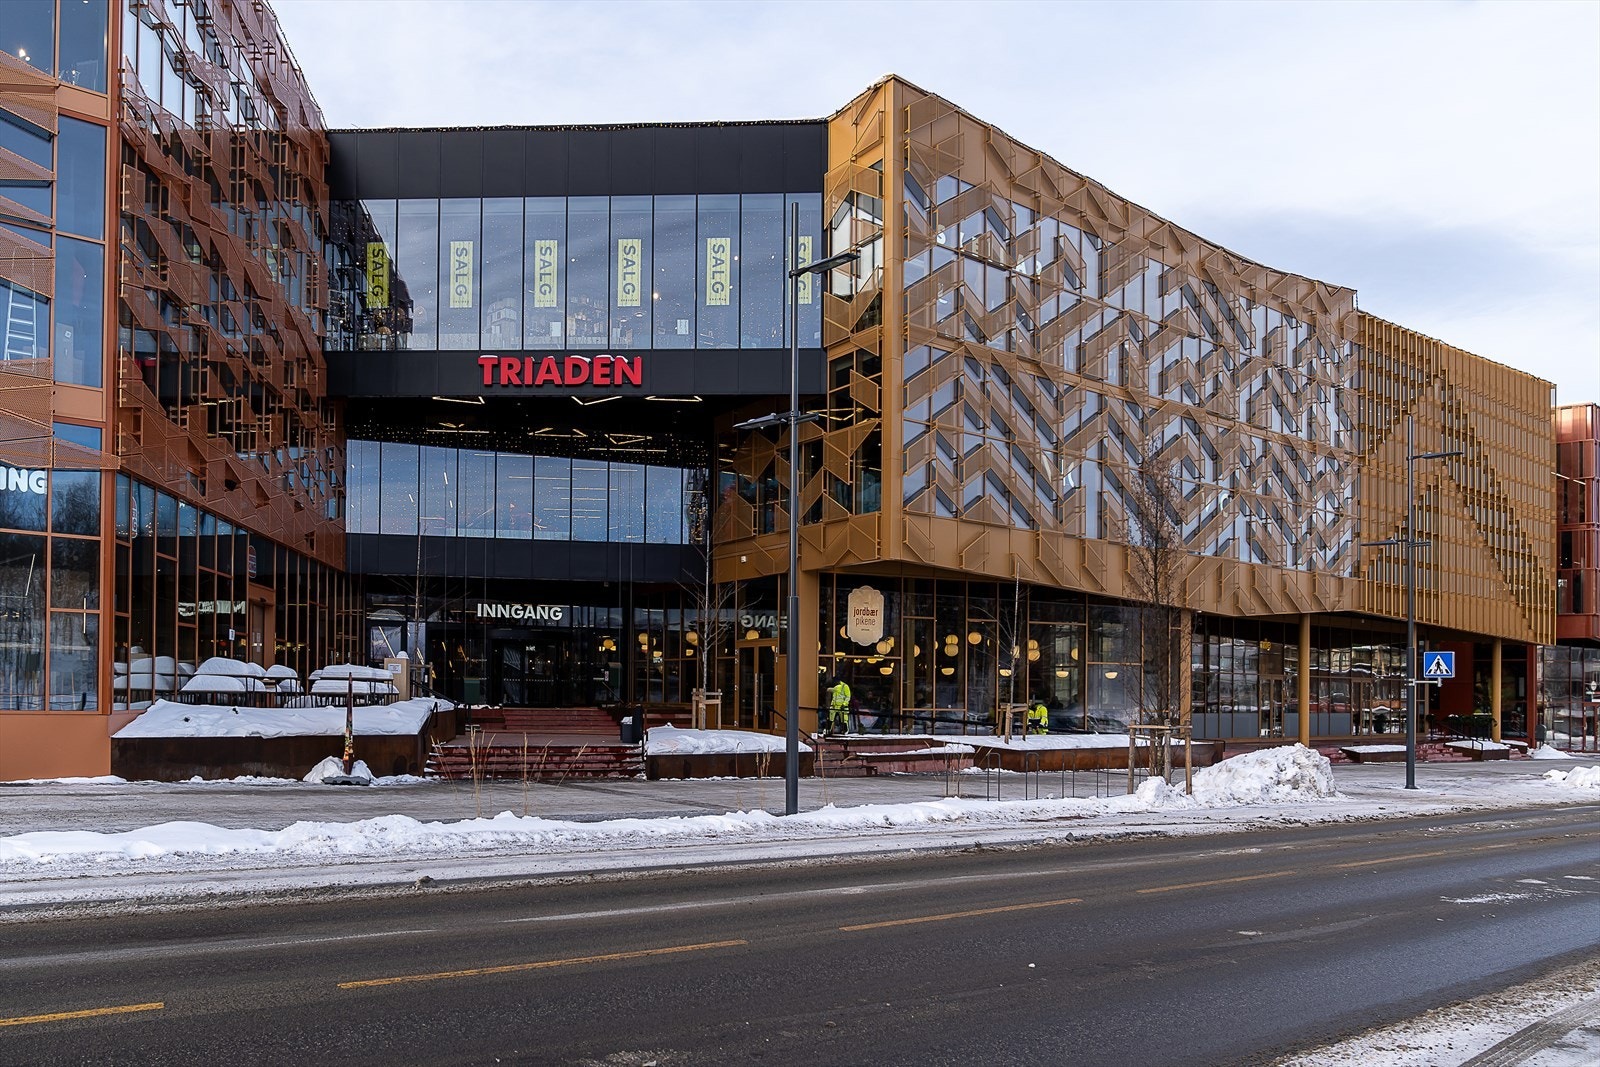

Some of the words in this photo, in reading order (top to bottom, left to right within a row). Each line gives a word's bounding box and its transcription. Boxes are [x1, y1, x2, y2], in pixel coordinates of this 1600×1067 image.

[372, 248, 385, 297] SALG
[455, 247, 468, 296] SALG
[539, 246, 553, 296] SALG
[623, 245, 636, 295] SALG
[711, 243, 725, 293] SALG
[477, 355, 643, 386] TRIADEN
[477, 603, 563, 621] INNGANG
[853, 606, 879, 617] jordbær
[855, 616, 876, 627] pikene
